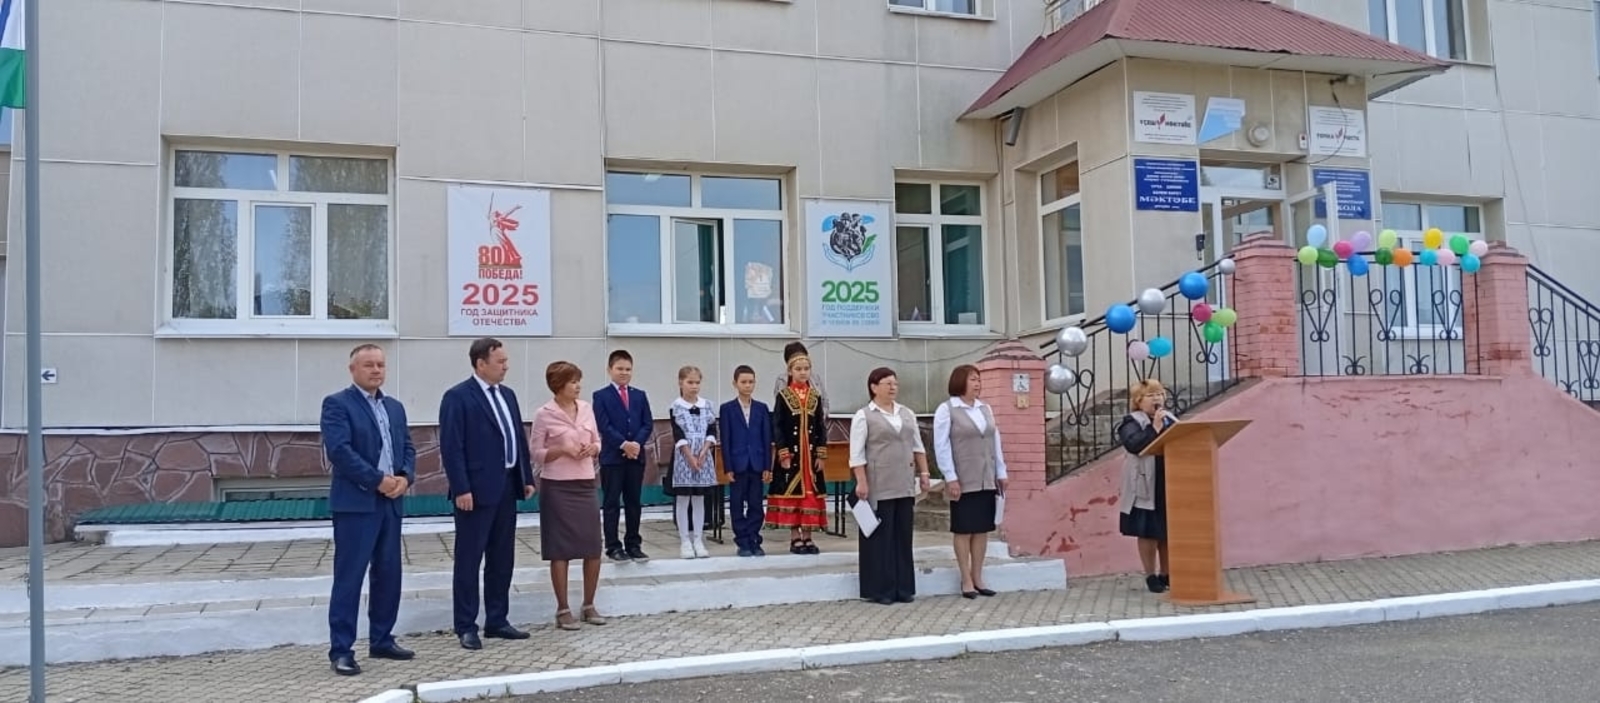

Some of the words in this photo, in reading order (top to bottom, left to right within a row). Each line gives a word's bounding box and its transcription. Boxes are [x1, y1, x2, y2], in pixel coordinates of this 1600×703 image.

[1337, 204, 1363, 212] КОЛА
[478, 245, 502, 266] 80
[478, 268, 523, 280] ПОБЕДА!
[462, 283, 539, 306] 2025
[821, 280, 880, 303] 2025
[460, 308, 479, 317] ГОД
[481, 308, 538, 317] ЗАЩИТНИКА
[472, 318, 527, 326] ОТЕЧЕСТВА
